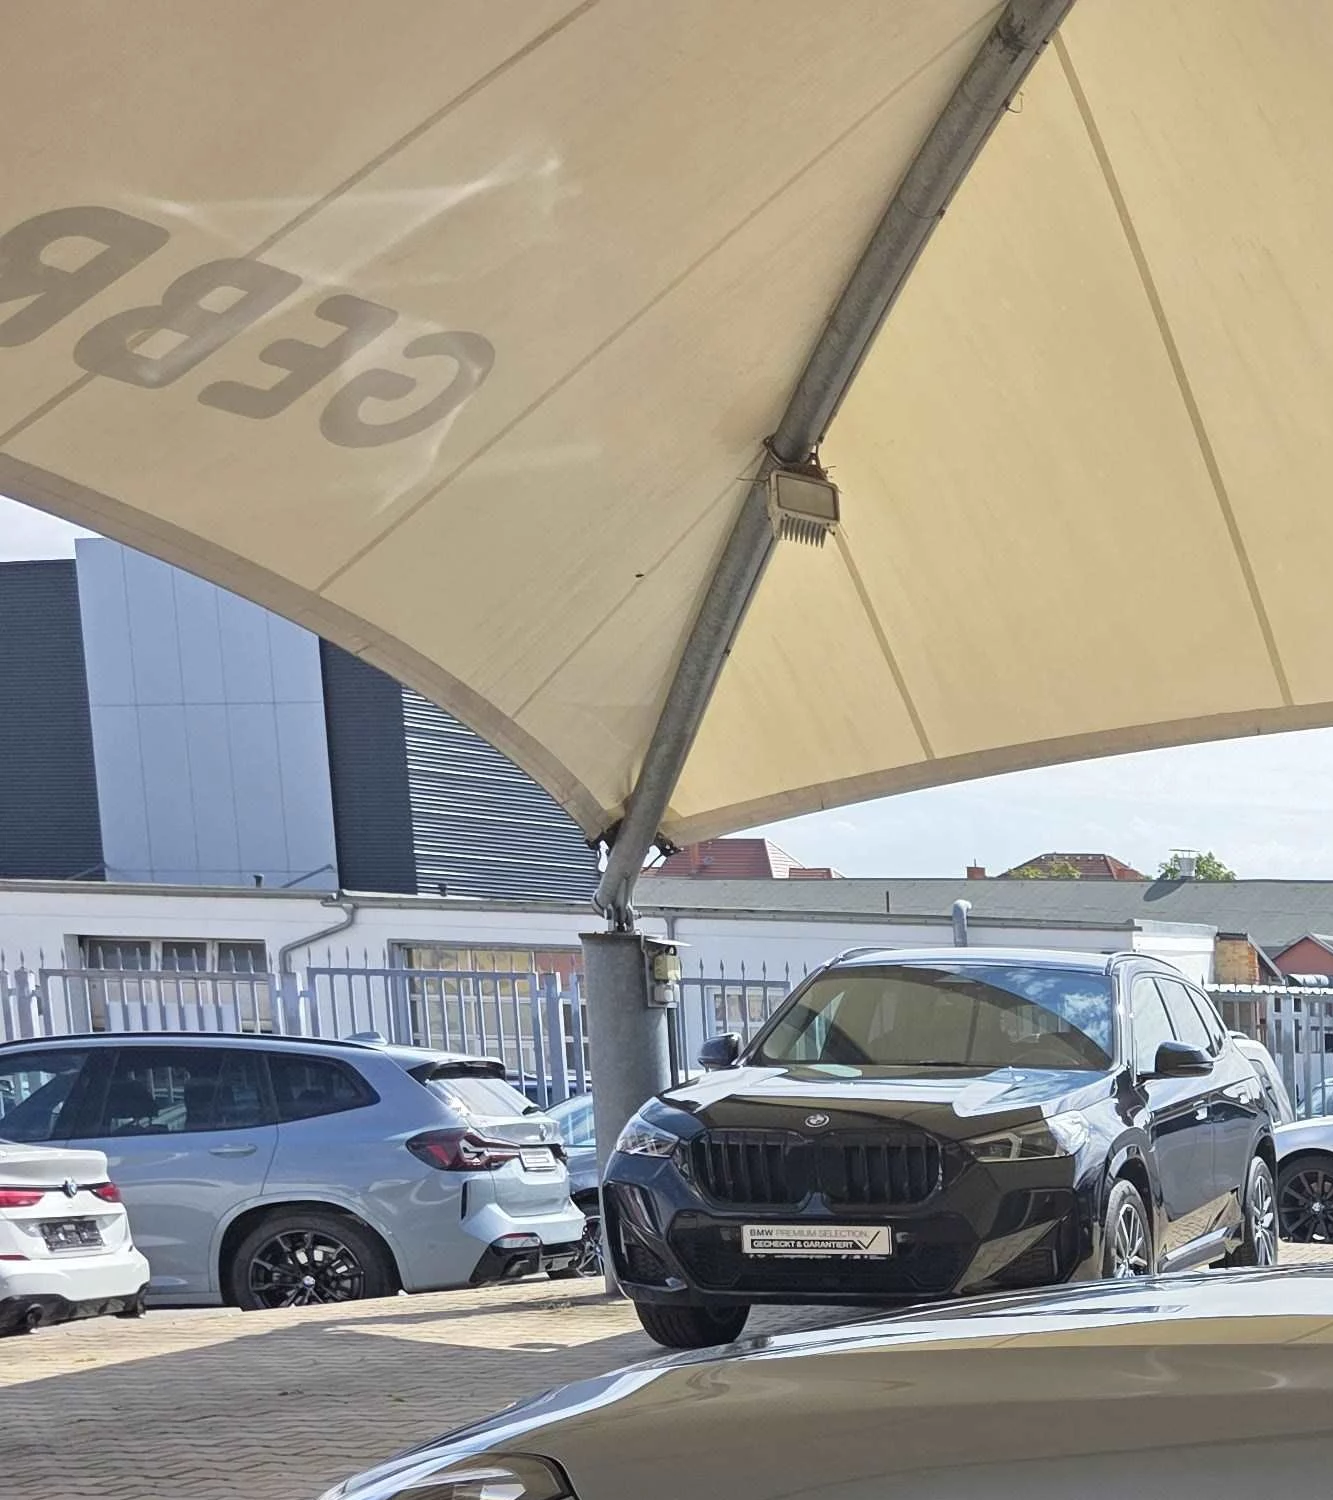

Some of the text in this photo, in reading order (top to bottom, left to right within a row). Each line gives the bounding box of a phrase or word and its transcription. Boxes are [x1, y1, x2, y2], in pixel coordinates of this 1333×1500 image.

[750, 1229, 773, 1237] BMW
[776, 1229, 817, 1237] PREMIUM
[753, 1240, 854, 1249] GECHECKT & GARANTIERT
